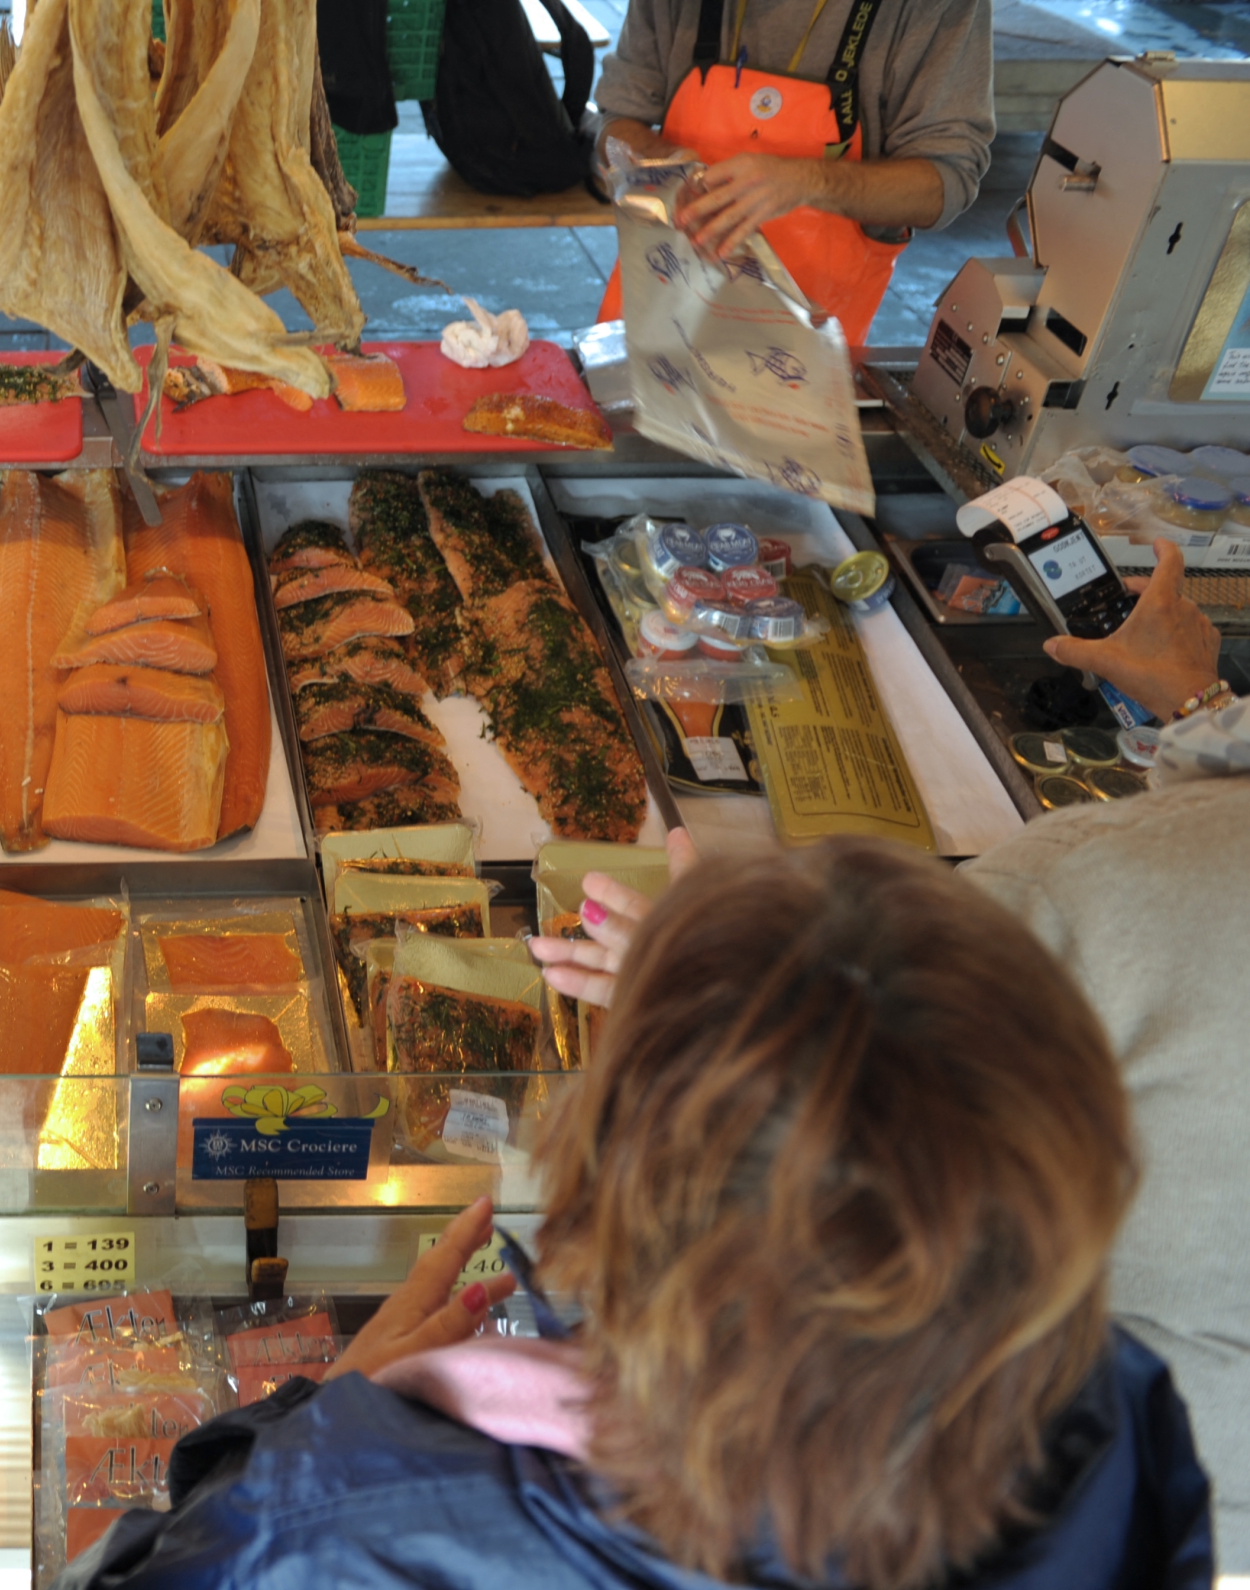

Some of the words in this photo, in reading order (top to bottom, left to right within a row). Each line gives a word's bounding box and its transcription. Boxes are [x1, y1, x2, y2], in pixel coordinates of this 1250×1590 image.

[1117, 703, 1134, 727] VISA
[240, 1138, 281, 1153] MSC
[287, 1138, 358, 1153] Crociere
[215, 1165, 244, 1176] MSC
[248, 1165, 324, 1177] Recommended
[327, 1165, 355, 1177] Store
[43, 1240, 53, 1252] 1
[87, 1237, 130, 1251] 139
[41, 1260, 54, 1272] 3
[84, 1258, 128, 1271] 400
[39, 1280, 53, 1291] 6
[89, 1445, 169, 1488] Ækt
